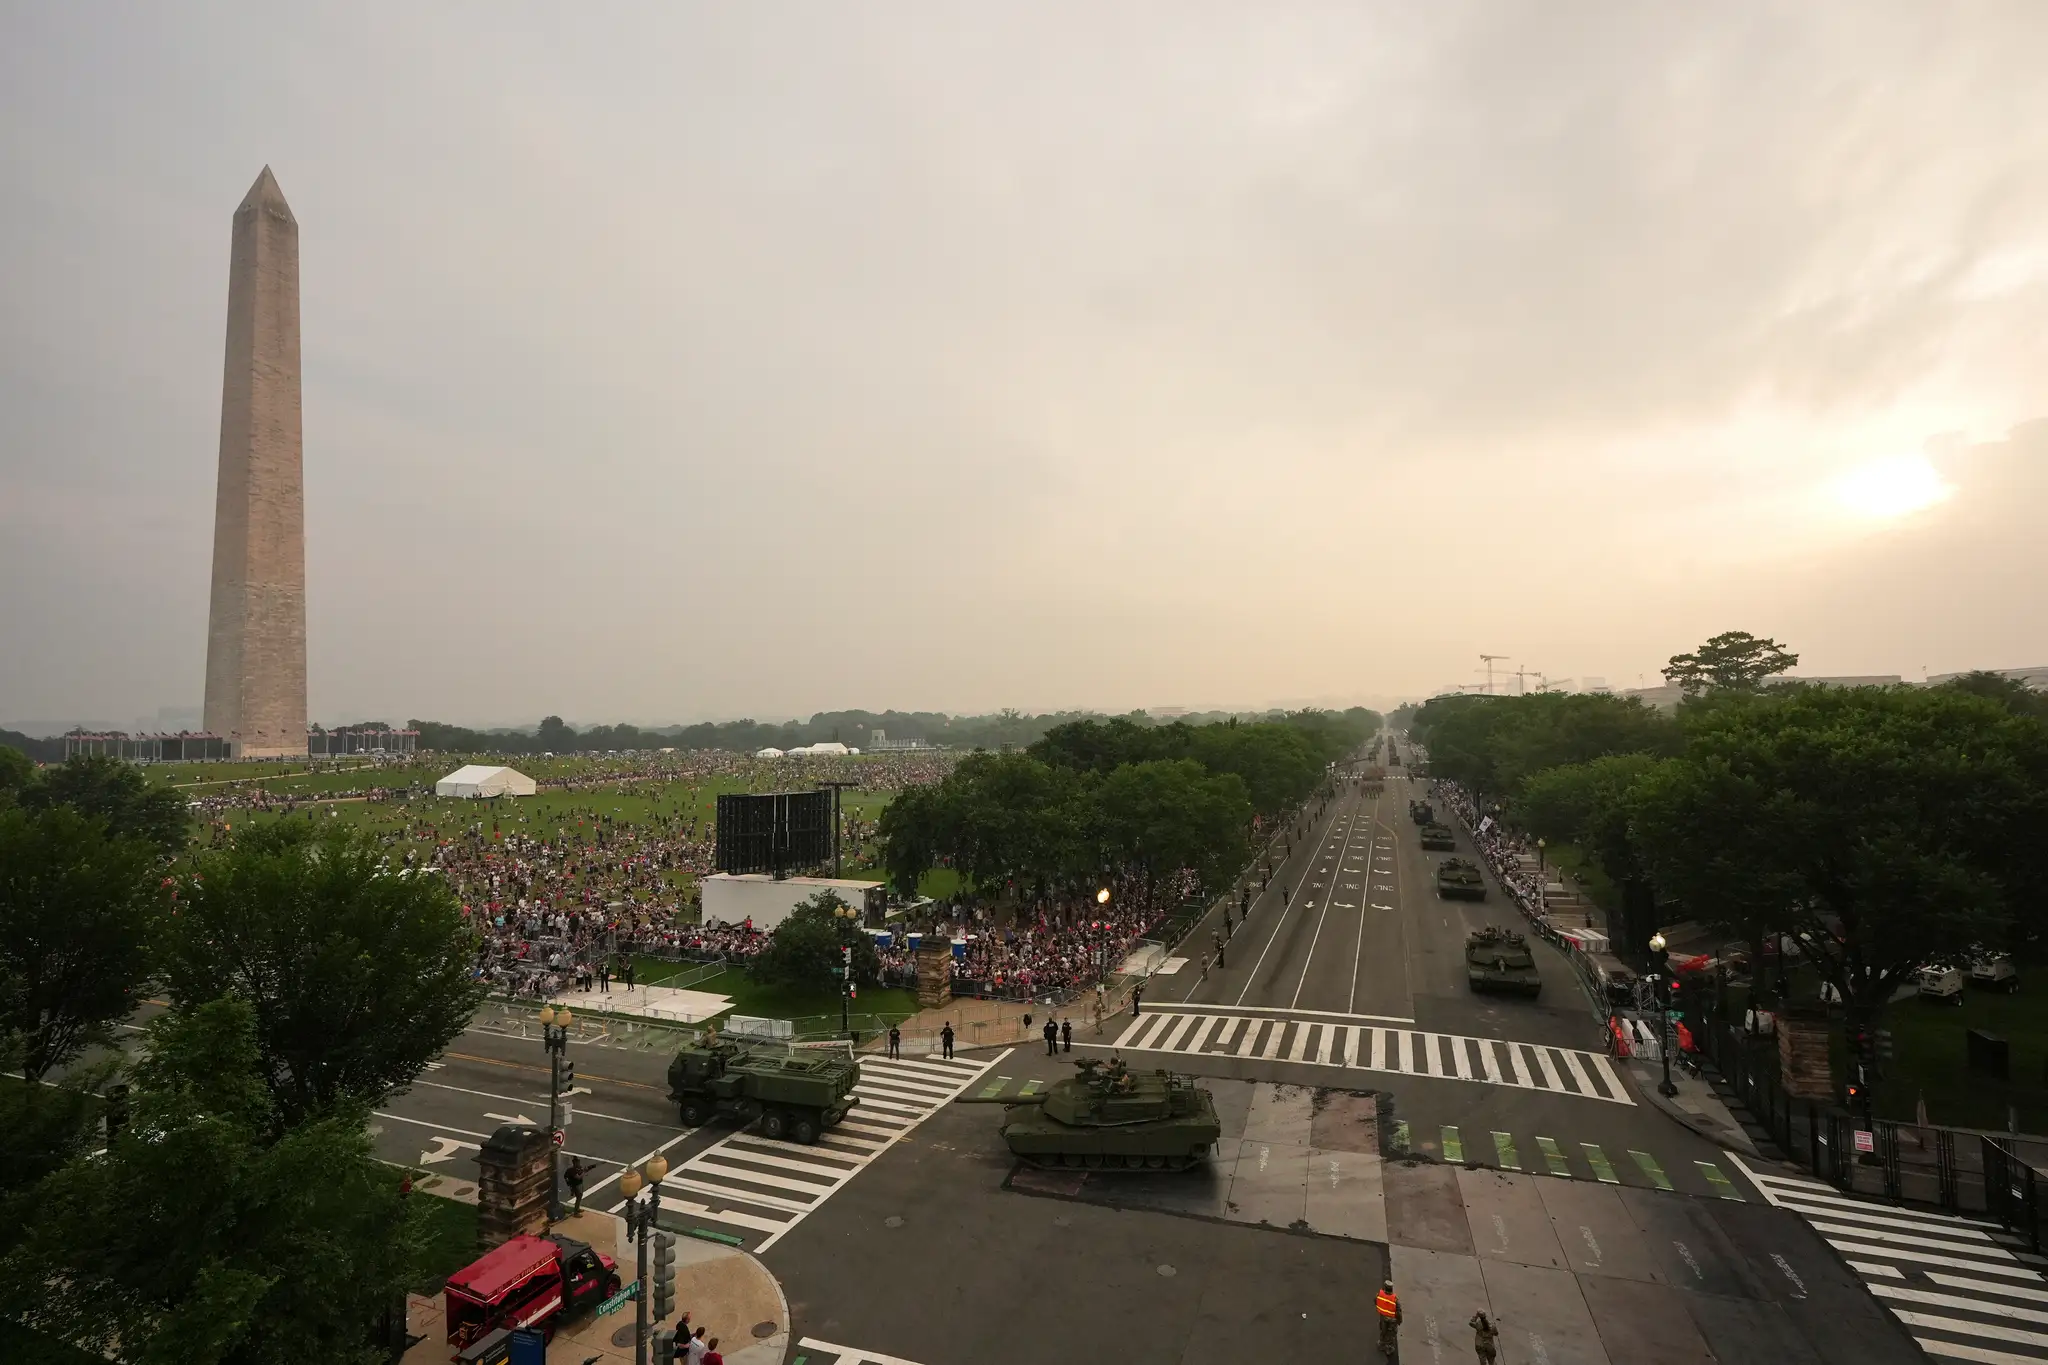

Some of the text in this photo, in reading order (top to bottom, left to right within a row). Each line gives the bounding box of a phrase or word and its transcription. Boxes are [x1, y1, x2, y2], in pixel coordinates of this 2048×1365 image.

[1372, 884, 1394, 892] ONLY
[521, 1265, 534, 1277] FIRE
[598, 1289, 631, 1315] Constitution
